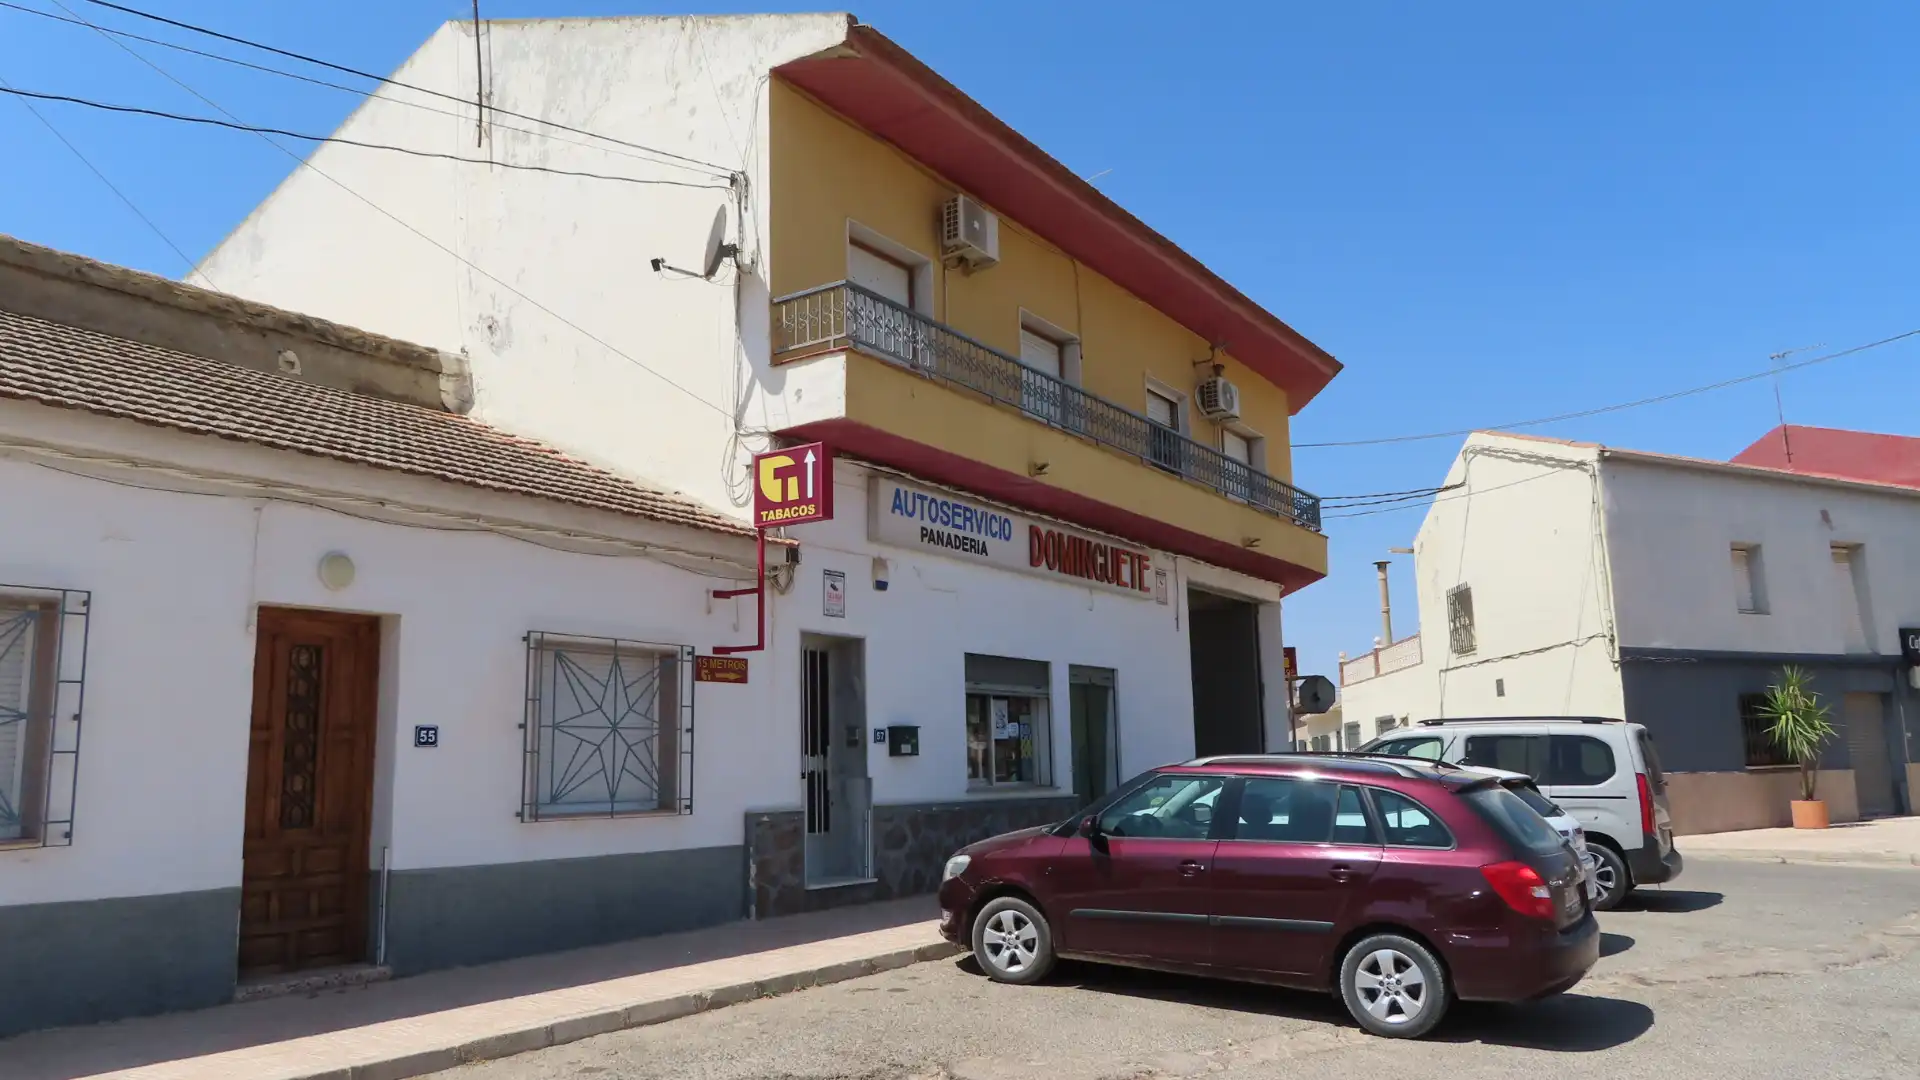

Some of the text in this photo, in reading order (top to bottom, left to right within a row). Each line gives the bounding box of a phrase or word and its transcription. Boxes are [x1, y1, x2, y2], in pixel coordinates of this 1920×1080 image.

[760, 504, 816, 522] TABACOS
[891, 487, 1012, 542] AUTOSERVICIO
[920, 525, 988, 556] PANADERIA
[1028, 524, 1151, 593] DOMINGUETE
[699, 658, 746, 670] 15 METROS
[420, 730, 435, 742] 55
[876, 731, 885, 740] 57
